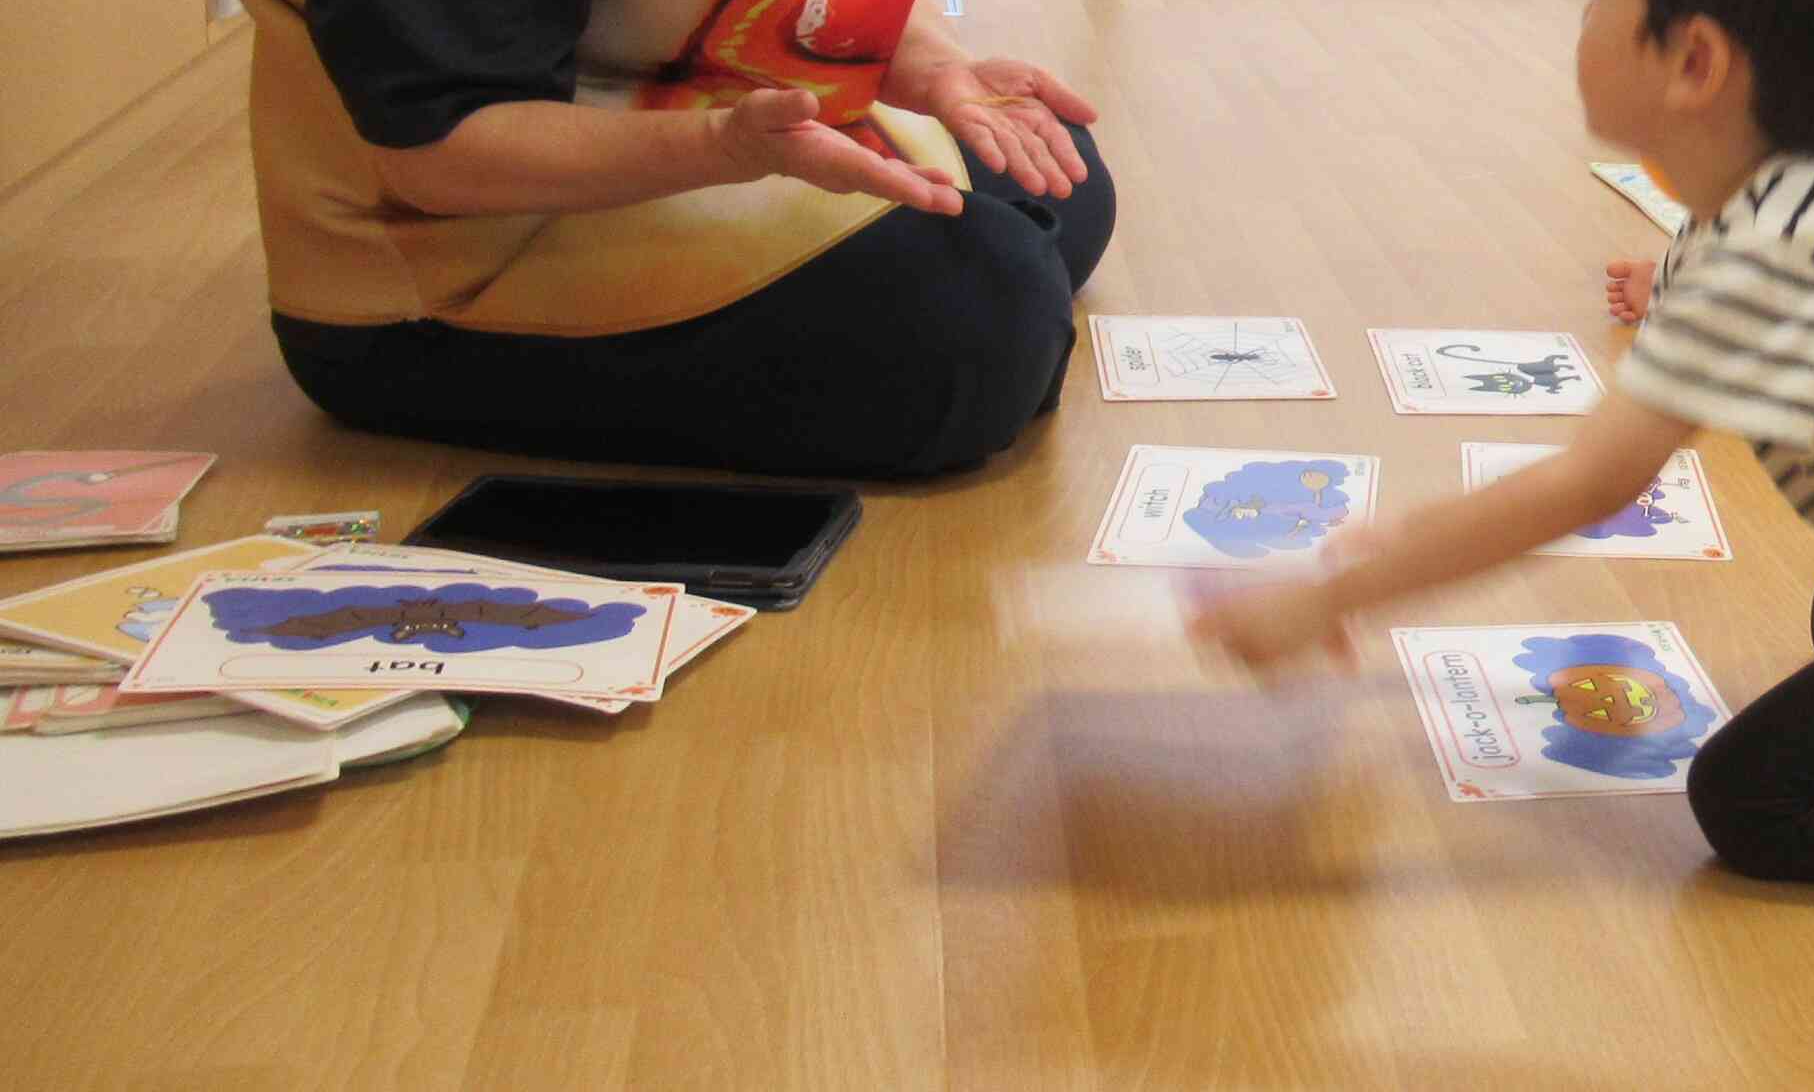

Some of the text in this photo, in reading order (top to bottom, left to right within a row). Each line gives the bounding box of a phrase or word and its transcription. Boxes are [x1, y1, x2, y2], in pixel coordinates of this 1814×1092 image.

[1121, 346, 1150, 371] spider
[1404, 367, 1433, 389] black
[1138, 489, 1170, 518] witch
[364, 660, 445, 674] bat
[1442, 654, 1515, 761] jack-o-lantern
